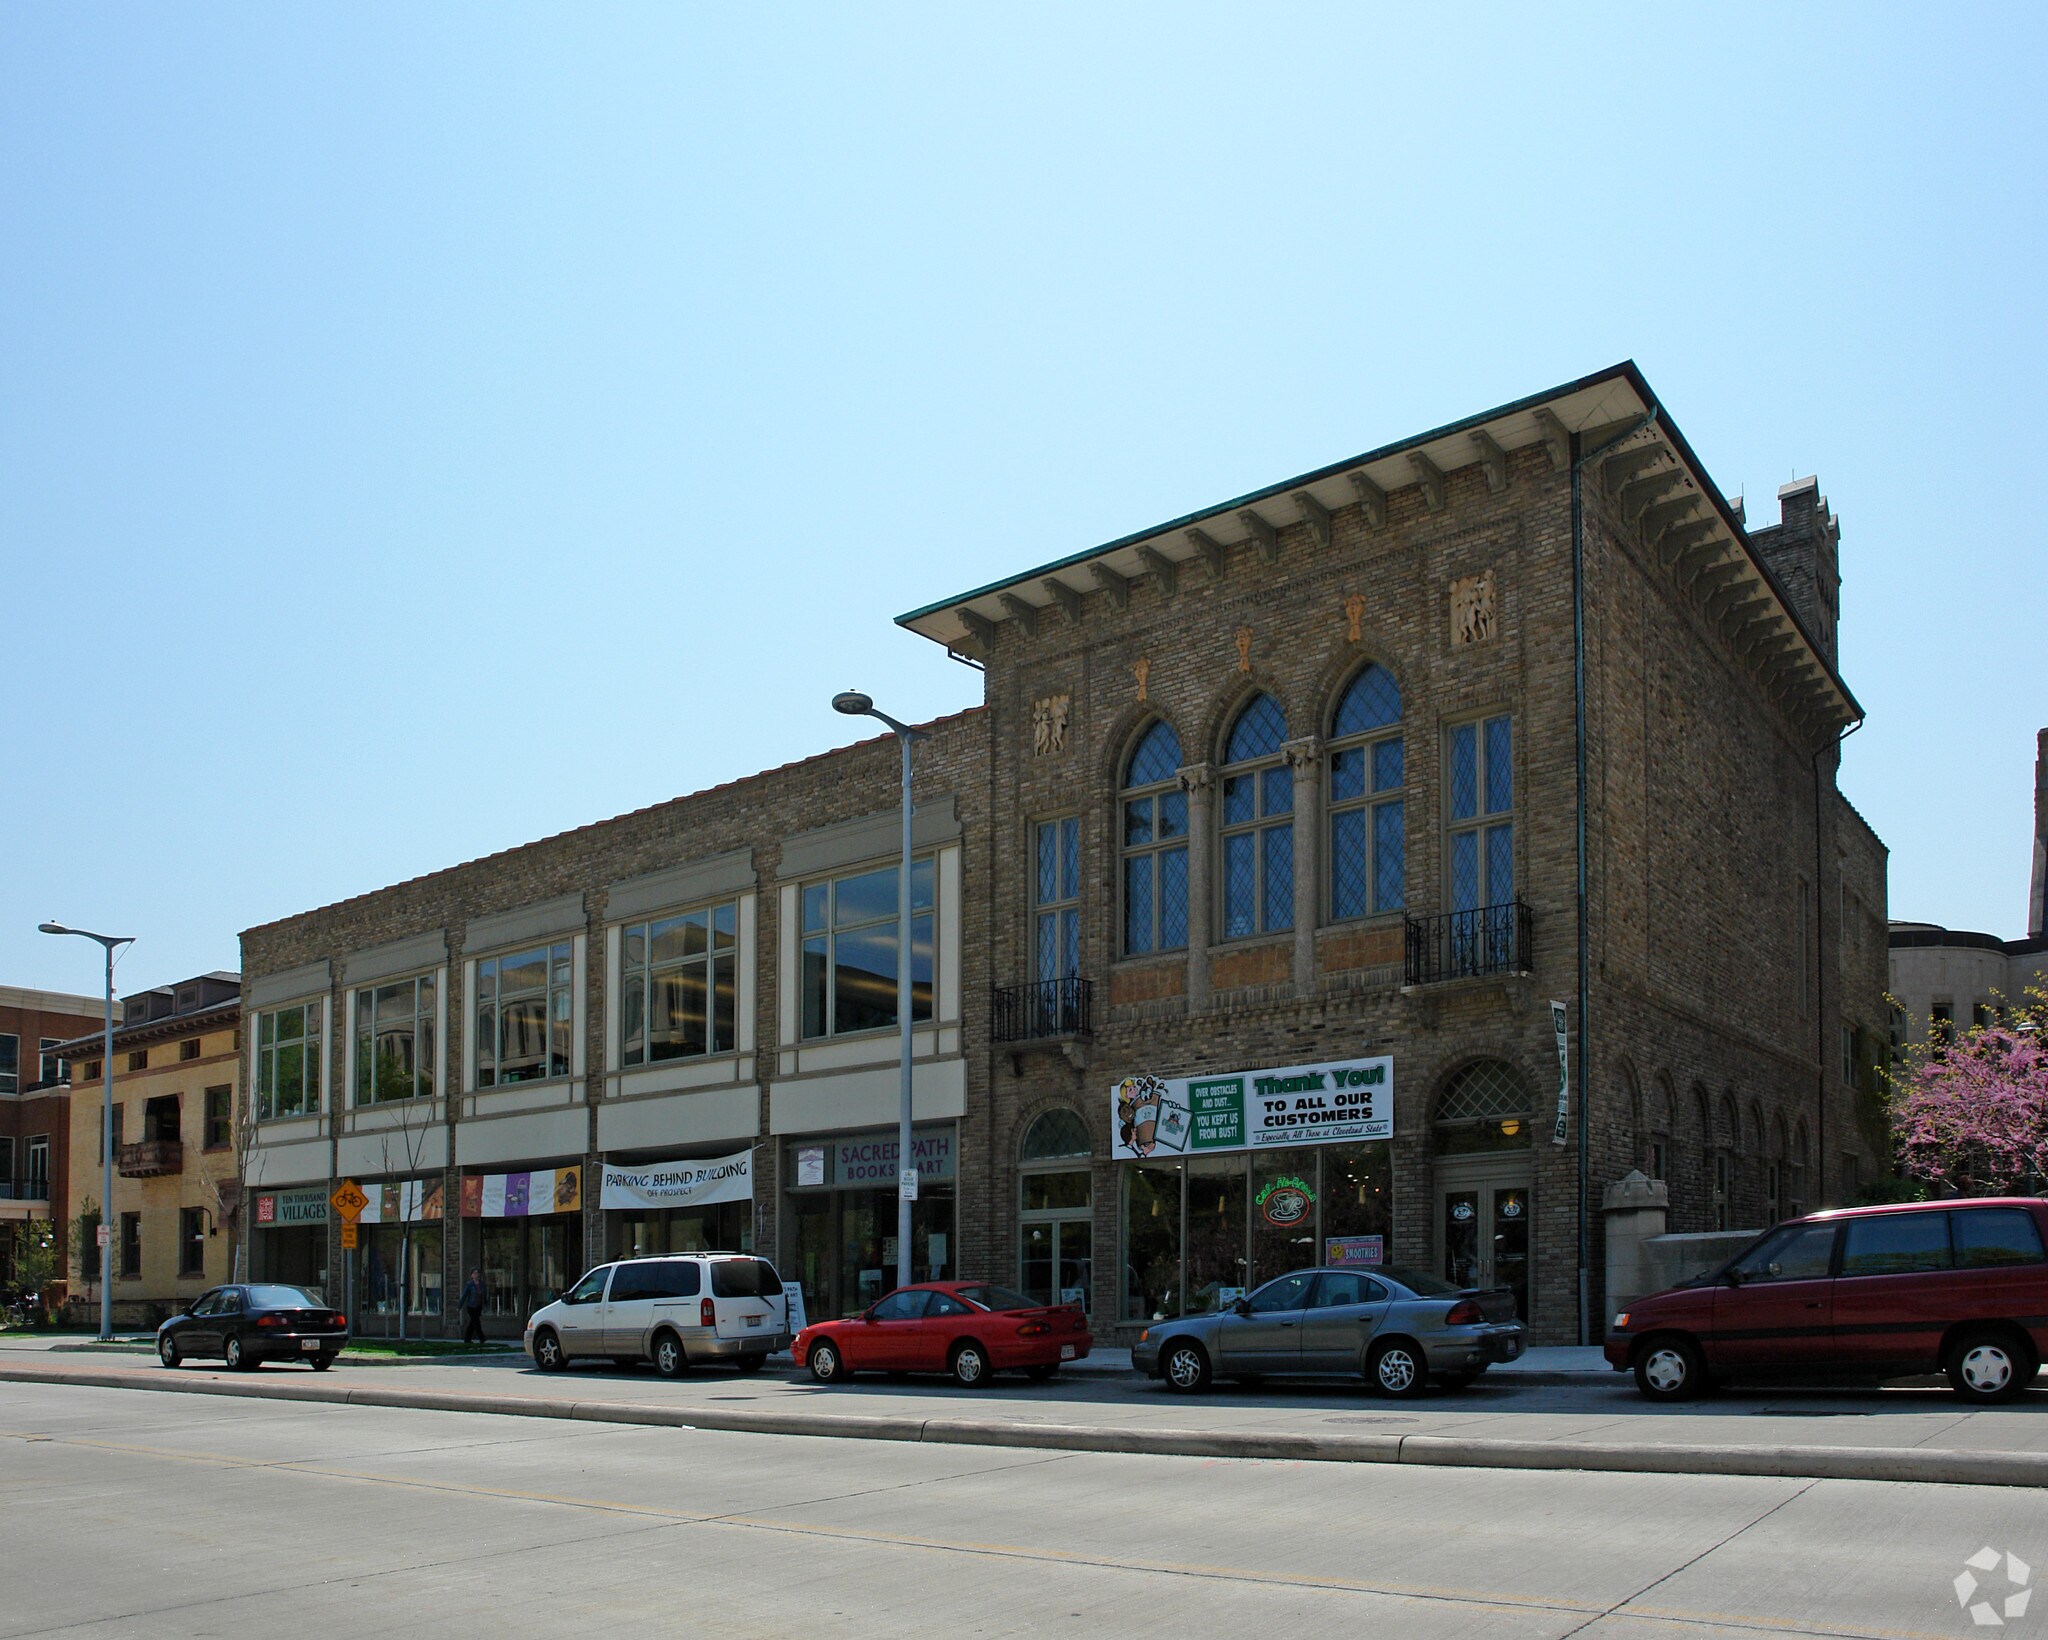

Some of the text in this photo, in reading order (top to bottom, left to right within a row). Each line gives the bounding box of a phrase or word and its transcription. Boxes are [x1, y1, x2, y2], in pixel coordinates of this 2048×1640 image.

[1254, 1065, 1385, 1096] Thank You!
[1195, 1084, 1238, 1098] OVER OBSTACLES
[1202, 1099, 1213, 1109] AND
[1264, 1092, 1373, 1112] TO ALL OUR
[1197, 1112, 1238, 1127] YOU KEPT US
[1264, 1107, 1373, 1127] CUSTOMERS
[1199, 1127, 1238, 1140] FROM BUST!
[1262, 1132, 1291, 1143] Especially
[1292, 1130, 1302, 1138] All
[1305, 1129, 1320, 1137] Those
[1332, 1124, 1363, 1136] Cleveland
[1365, 1123, 1383, 1133] State
[841, 1138, 949, 1164] SACRED PATH
[606, 1161, 747, 1187] PARKING BEHIND BUILDING
[848, 1159, 943, 1180] BOOKS ART
[282, 1192, 327, 1204] TEN THOUSAND
[647, 1187, 692, 1197] OFF PROSPECT
[282, 1203, 327, 1220] VILLAGES
[1345, 1247, 1378, 1260] SMOOTHIES
